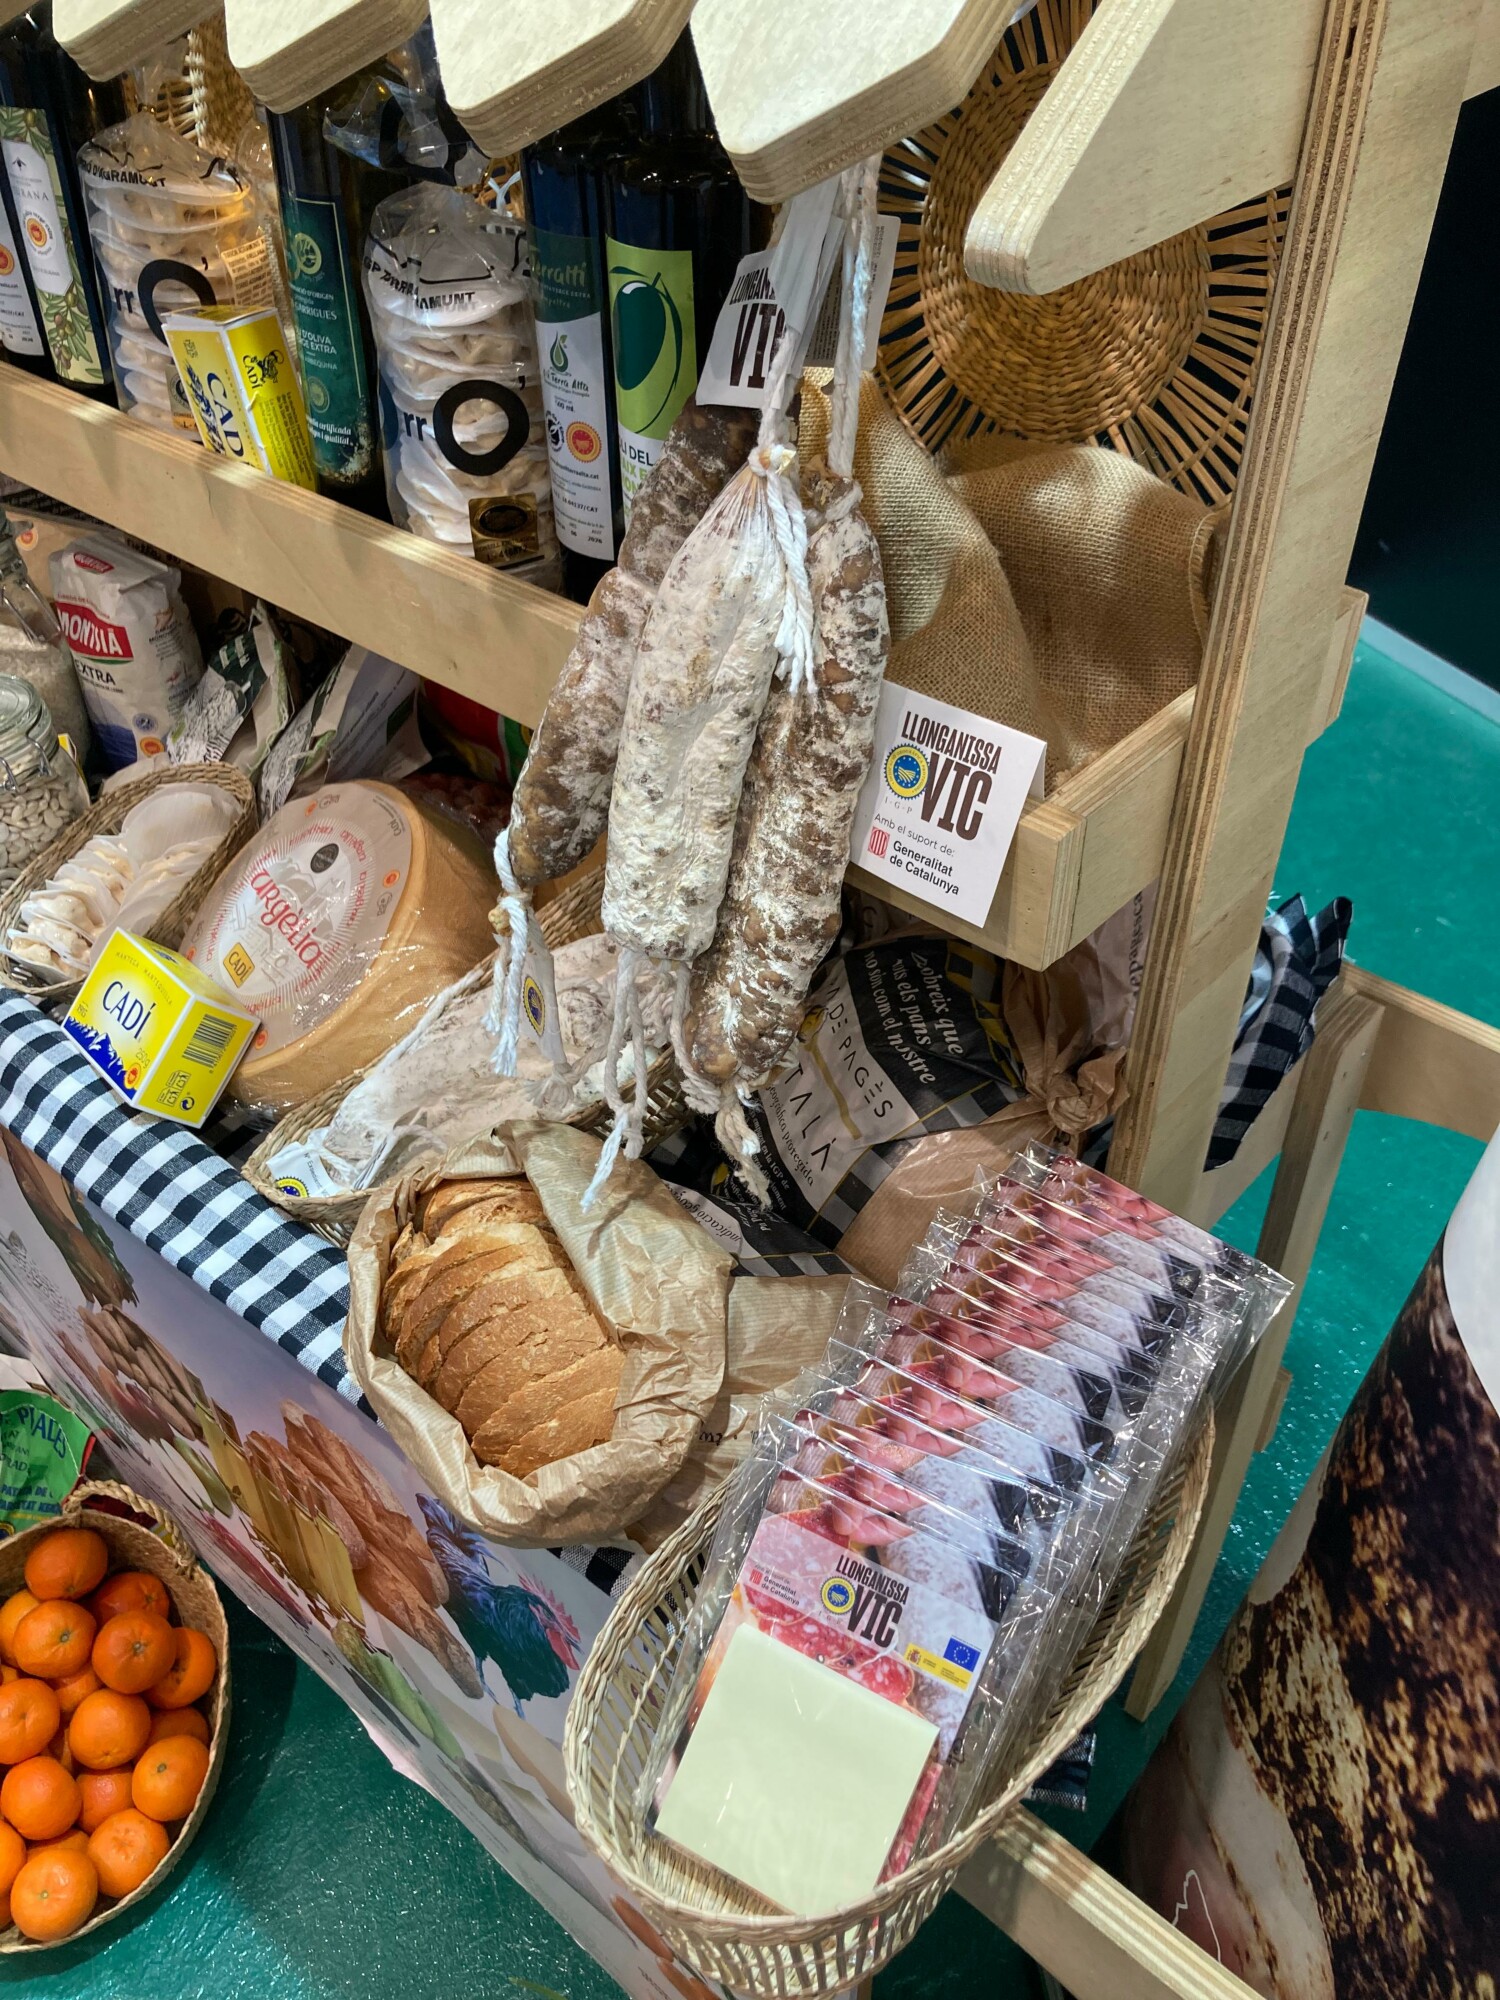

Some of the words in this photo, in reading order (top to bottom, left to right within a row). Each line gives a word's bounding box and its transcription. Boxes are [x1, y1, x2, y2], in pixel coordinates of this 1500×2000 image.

[628, 444, 654, 468] DEL
[901, 711, 1003, 775] LLONGANISSA
[920, 751, 993, 841] VIC
[874, 812, 896, 831] Amb
[897, 823, 906, 835] el
[906, 829, 938, 850] suport
[939, 842, 956, 858] de:
[892, 839, 954, 878] Generalitat
[889, 854, 904, 869] de
[904, 861, 960, 896] Catalunya
[102, 980, 158, 1040] CADÍ
[863, 950, 877, 970] no
[872, 988, 890, 1012] com
[881, 1010, 897, 1032] el
[897, 980, 915, 1004] els
[907, 1004, 932, 1046] pans
[934, 1015, 964, 1056] que
[838, 1035, 893, 1119] PAGÈS
[769, 1162, 786, 1179] IGP
[780, 1179, 791, 1191] de
[781, 1131, 814, 1188] protegida
[761, 1582, 770, 1591] de
[769, 1586, 800, 1606] Catalunya
[763, 1575, 798, 1597] Generalitat
[835, 1554, 910, 1605] LLONGANISSA
[846, 1584, 903, 1648] VIC
